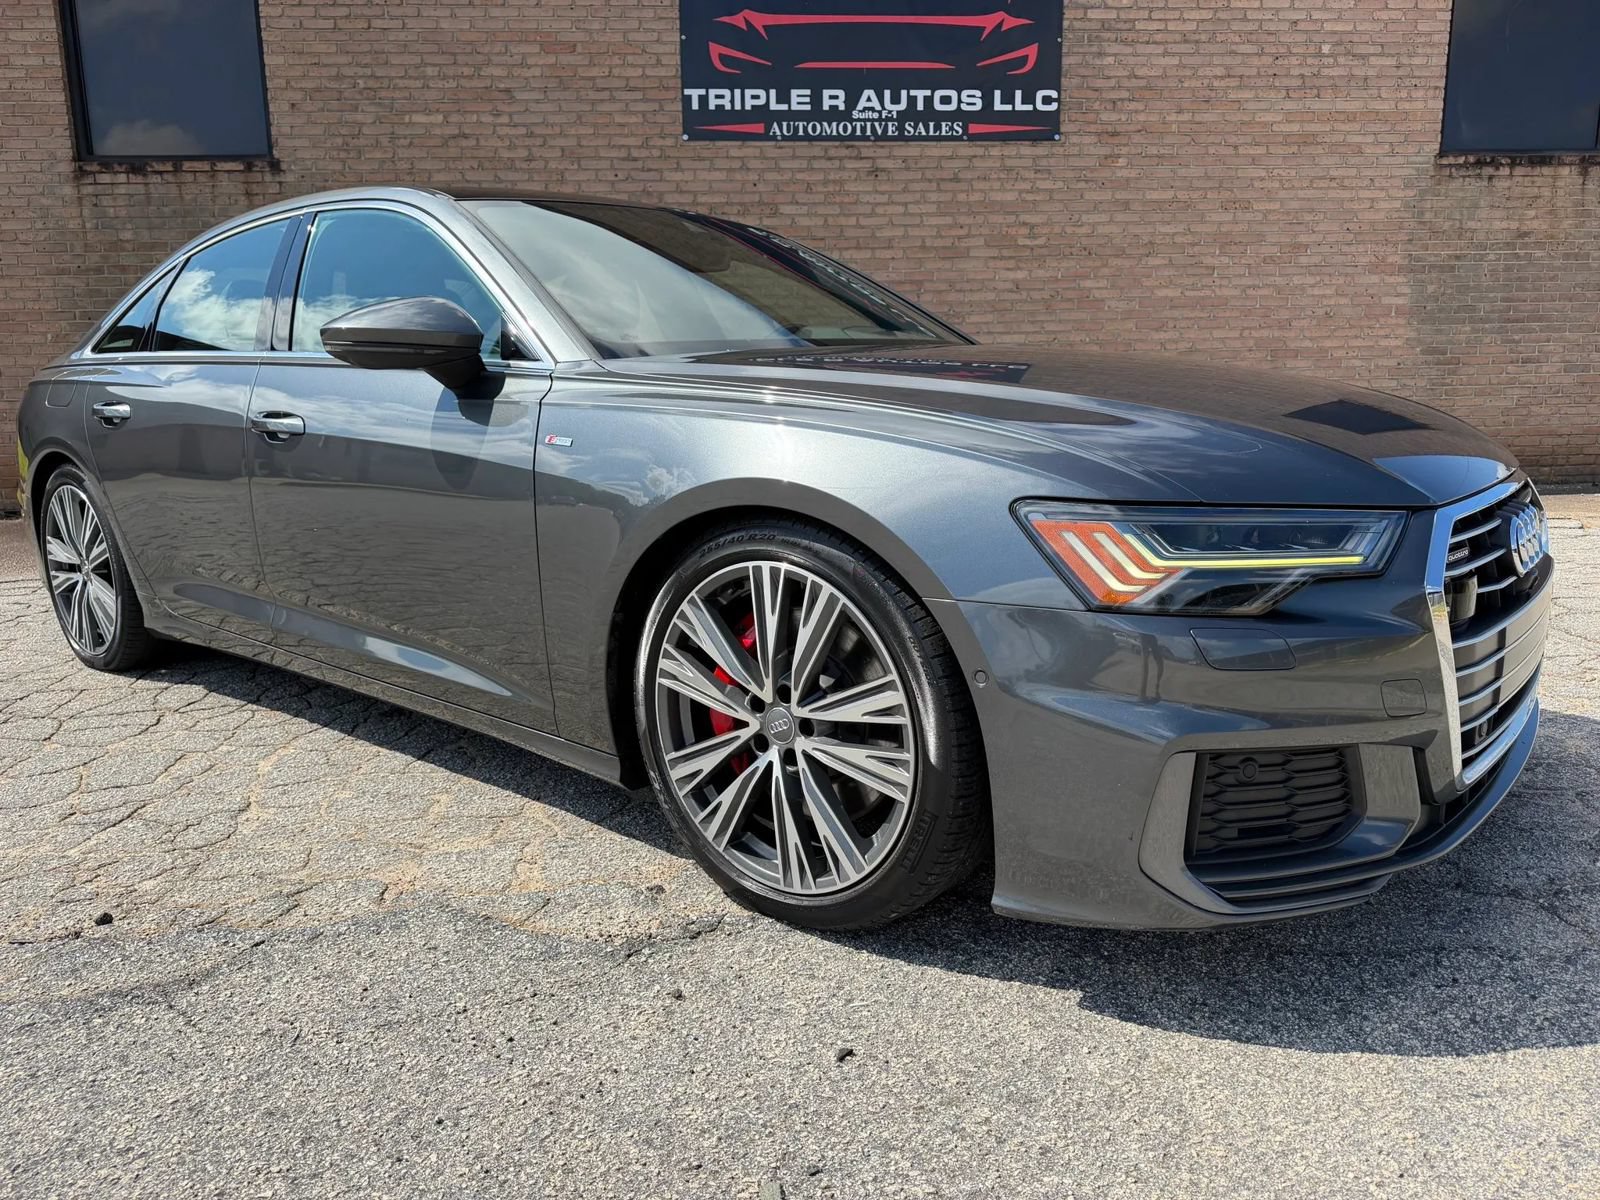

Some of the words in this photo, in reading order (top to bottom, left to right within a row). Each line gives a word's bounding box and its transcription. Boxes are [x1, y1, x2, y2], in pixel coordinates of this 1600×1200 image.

[683, 88, 812, 111] TRIPLE
[822, 89, 846, 111] R
[855, 89, 983, 112] AUTOS
[993, 89, 1059, 112] LLC
[852, 110, 880, 119] Suite
[881, 110, 898, 119] F-1
[769, 121, 899, 136] AUTOMOTIVE
[904, 121, 963, 136] SALES
